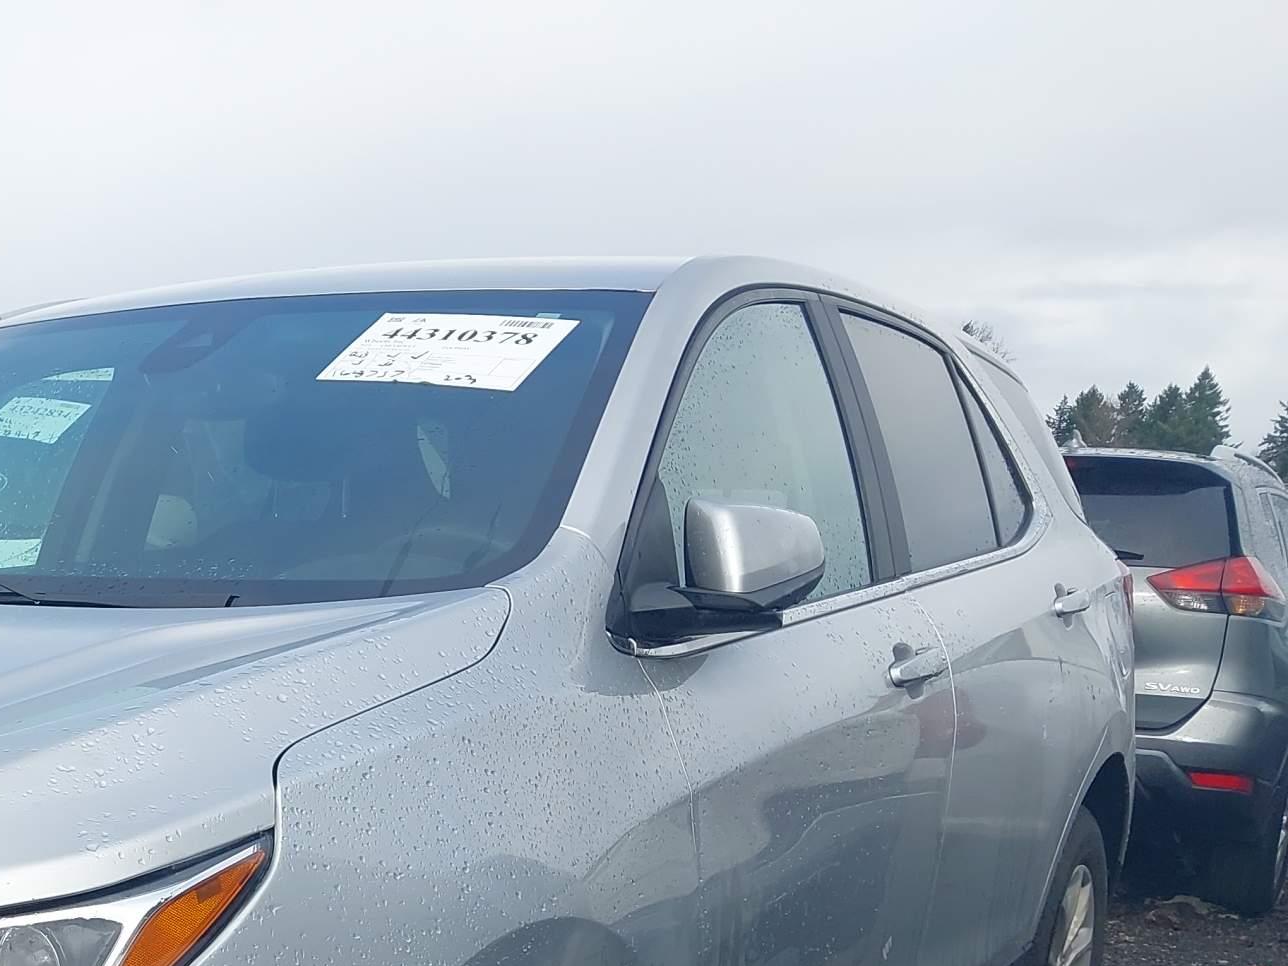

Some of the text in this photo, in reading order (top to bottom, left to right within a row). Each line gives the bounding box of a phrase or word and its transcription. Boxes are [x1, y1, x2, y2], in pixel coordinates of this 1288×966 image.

[382, 327, 539, 346] 44310378
[1144, 682, 1201, 694] SV AWD
